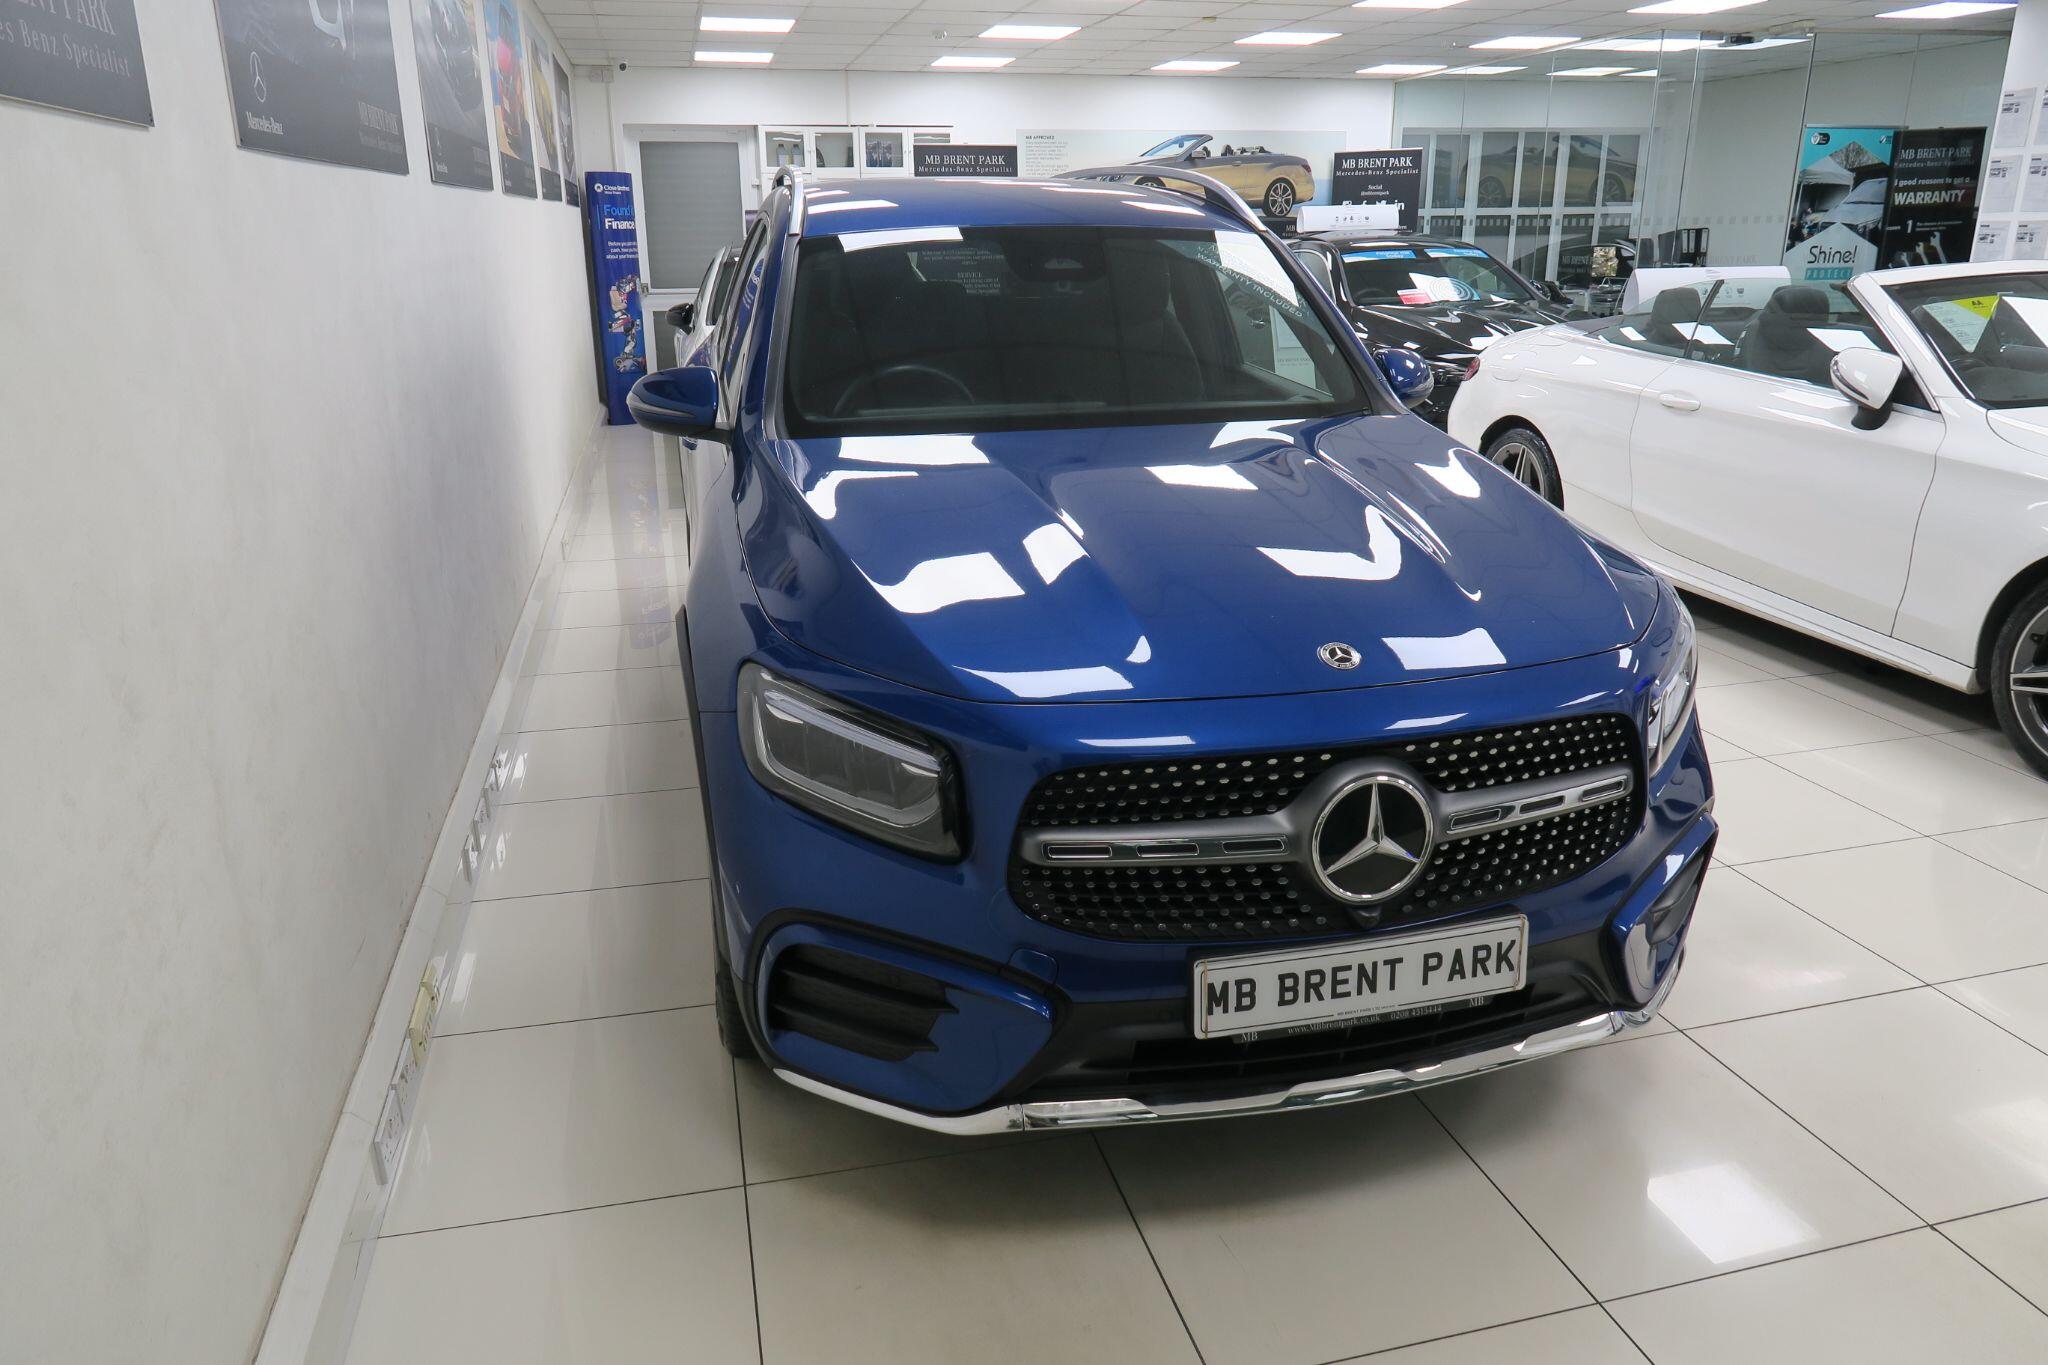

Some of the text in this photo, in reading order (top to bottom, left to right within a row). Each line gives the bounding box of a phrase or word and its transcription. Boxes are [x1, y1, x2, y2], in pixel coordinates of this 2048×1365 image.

[20, 19, 59, 56] Benz
[63, 32, 131, 77] Specialist
[1900, 146, 1972, 160] MB BRENT PARK
[925, 155, 1006, 165] MB BRENT PARK
[1342, 157, 1413, 169] MB BRENT PARK
[918, 165, 973, 173] Mercedes-Benz
[1898, 178, 1918, 188] good
[1894, 190, 1966, 206] WARRANTY
[604, 204, 630, 216] Found
[1906, 220, 1914, 234] 1
[1807, 245, 1858, 264] Shine!
[1197, 253, 1253, 287] WARRANTY
[1252, 284, 1303, 318] INCLUDED
[1207, 940, 1516, 1016] MB BRENT PARK
[1469, 996, 1484, 1008] MB
[1240, 1031, 1258, 1042] MB
